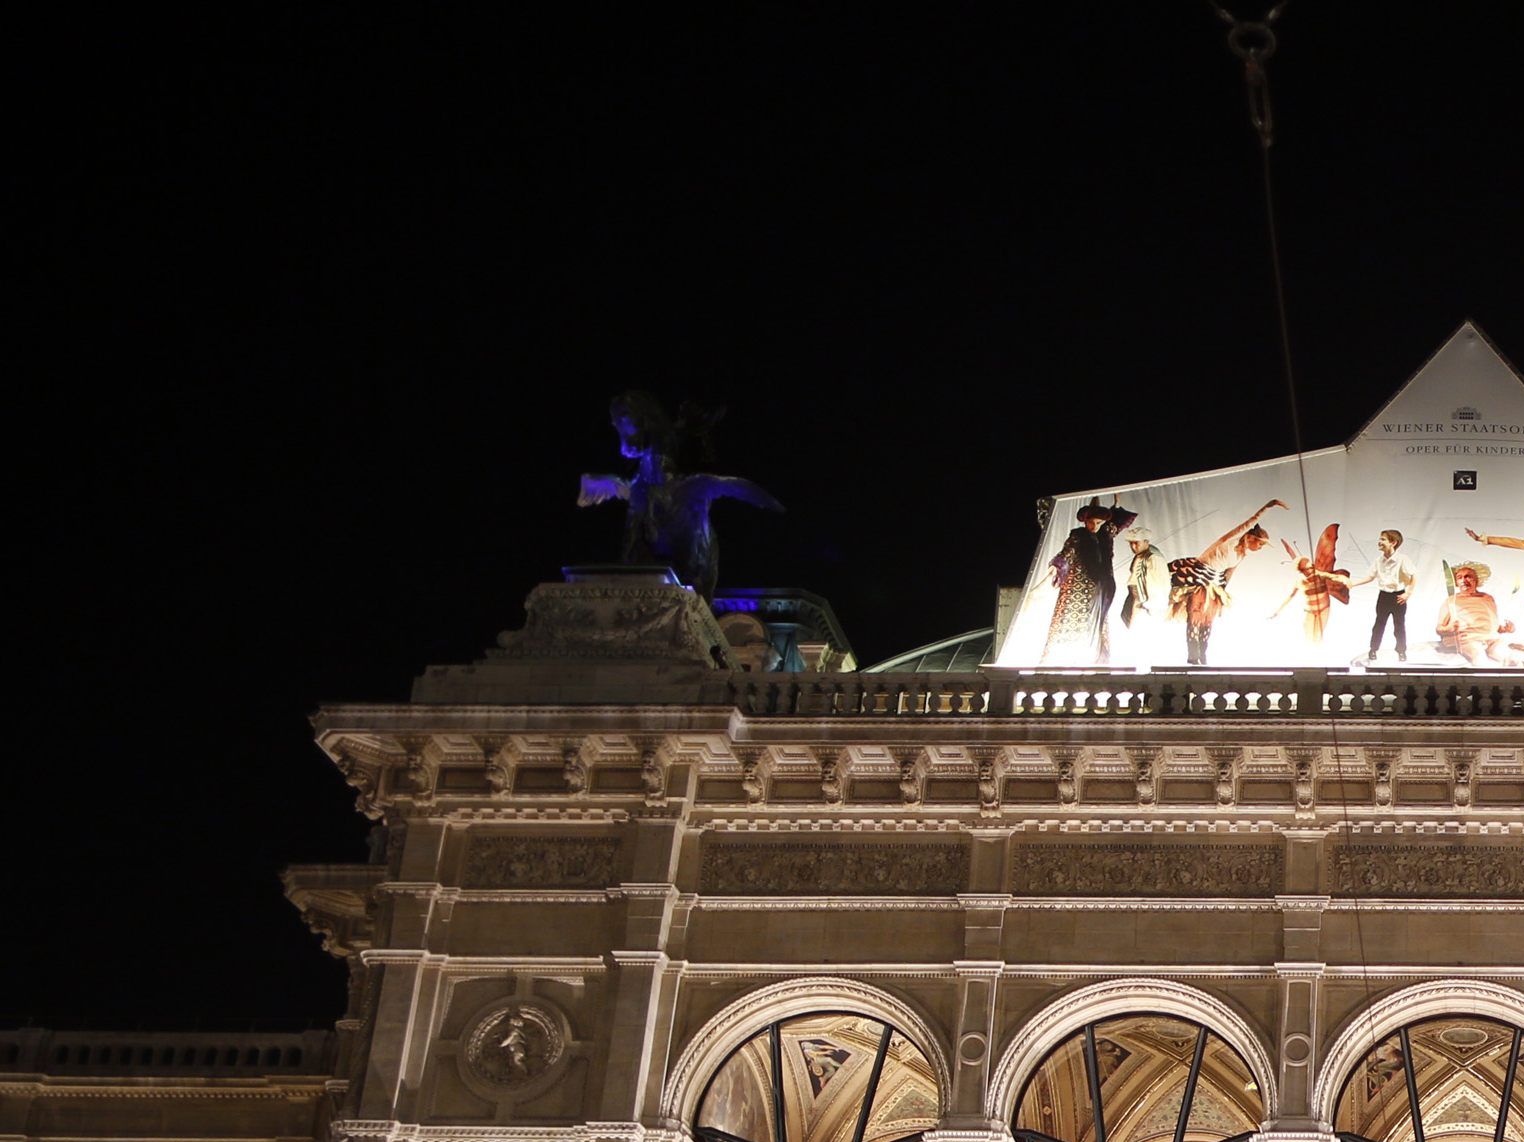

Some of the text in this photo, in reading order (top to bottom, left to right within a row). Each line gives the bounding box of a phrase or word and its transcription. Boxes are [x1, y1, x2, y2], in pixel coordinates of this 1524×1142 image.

[1382, 423, 1444, 433] WIENER
[1406, 445, 1440, 454] OPER
[1445, 443, 1471, 454] FÜR
